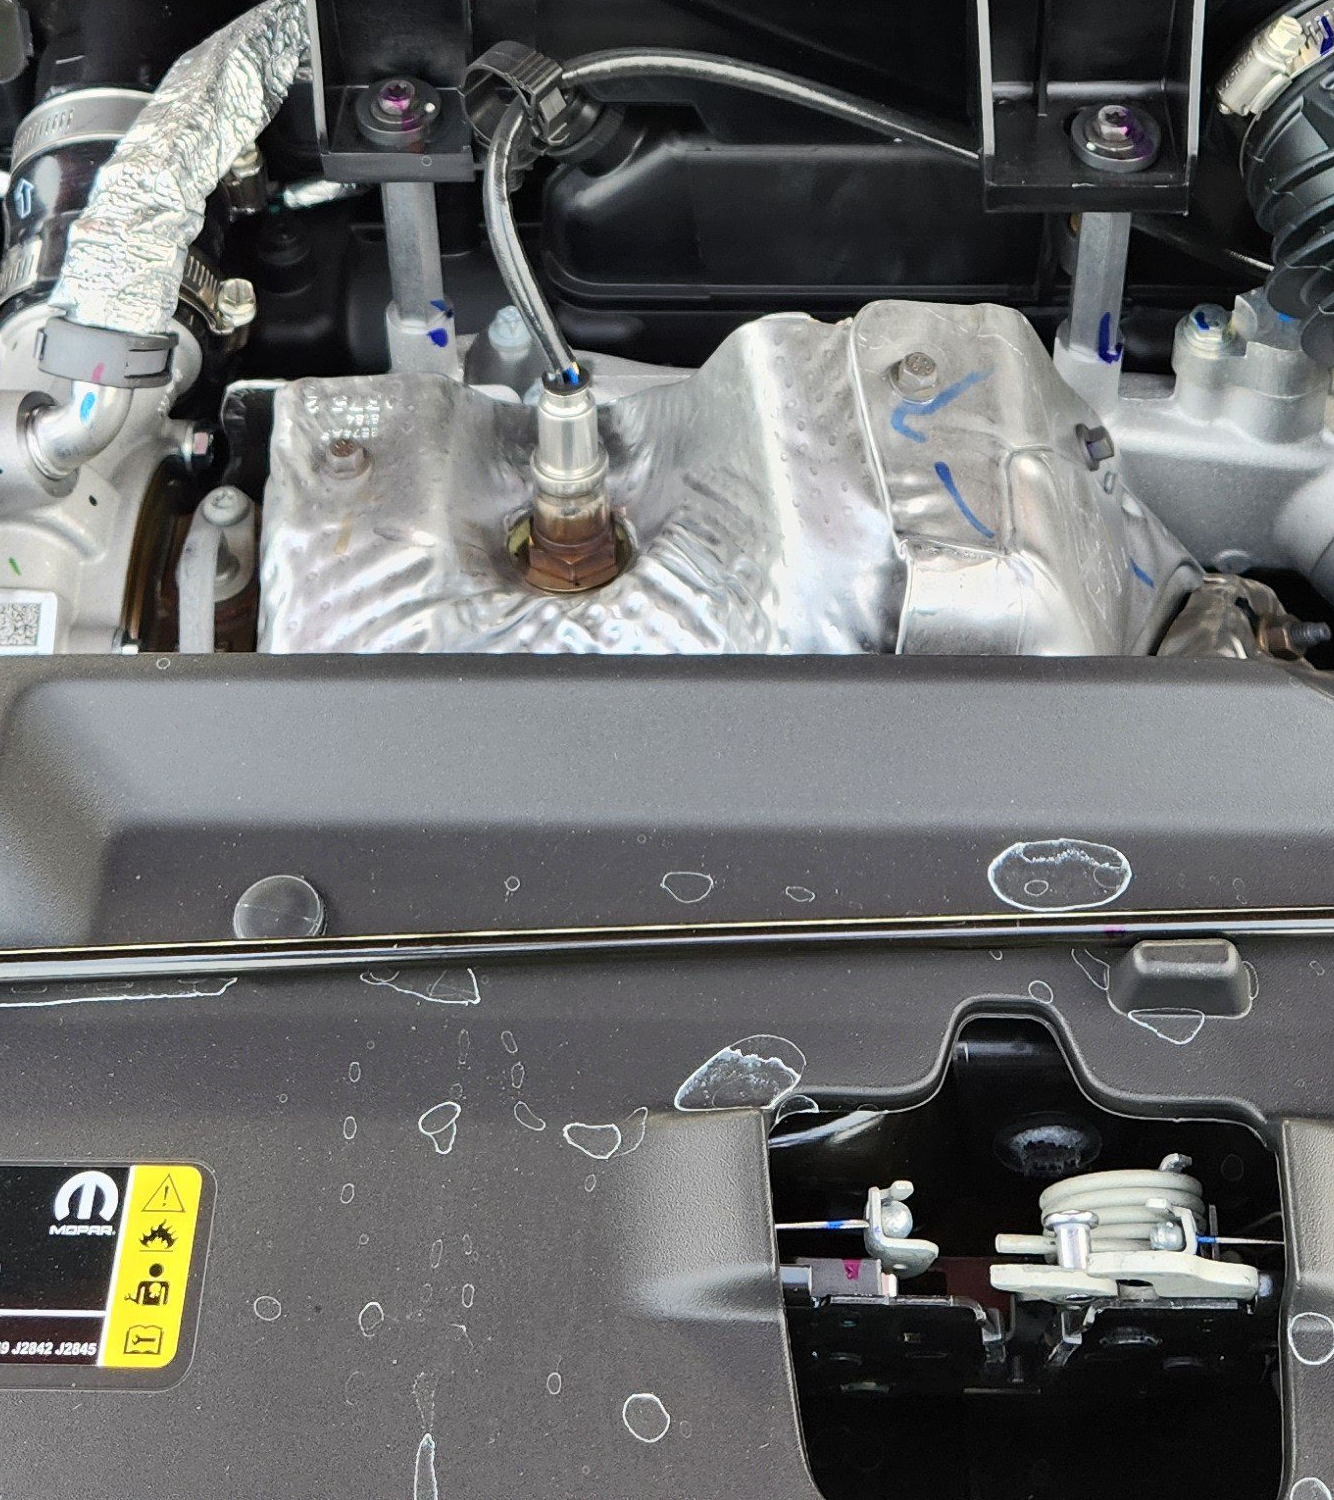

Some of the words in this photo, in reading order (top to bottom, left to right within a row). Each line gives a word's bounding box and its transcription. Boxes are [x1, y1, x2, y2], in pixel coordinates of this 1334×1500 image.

[49, 1224, 117, 1237] MOPAR
[12, 1339, 53, 1358] J2842
[55, 1339, 99, 1358] J2845
